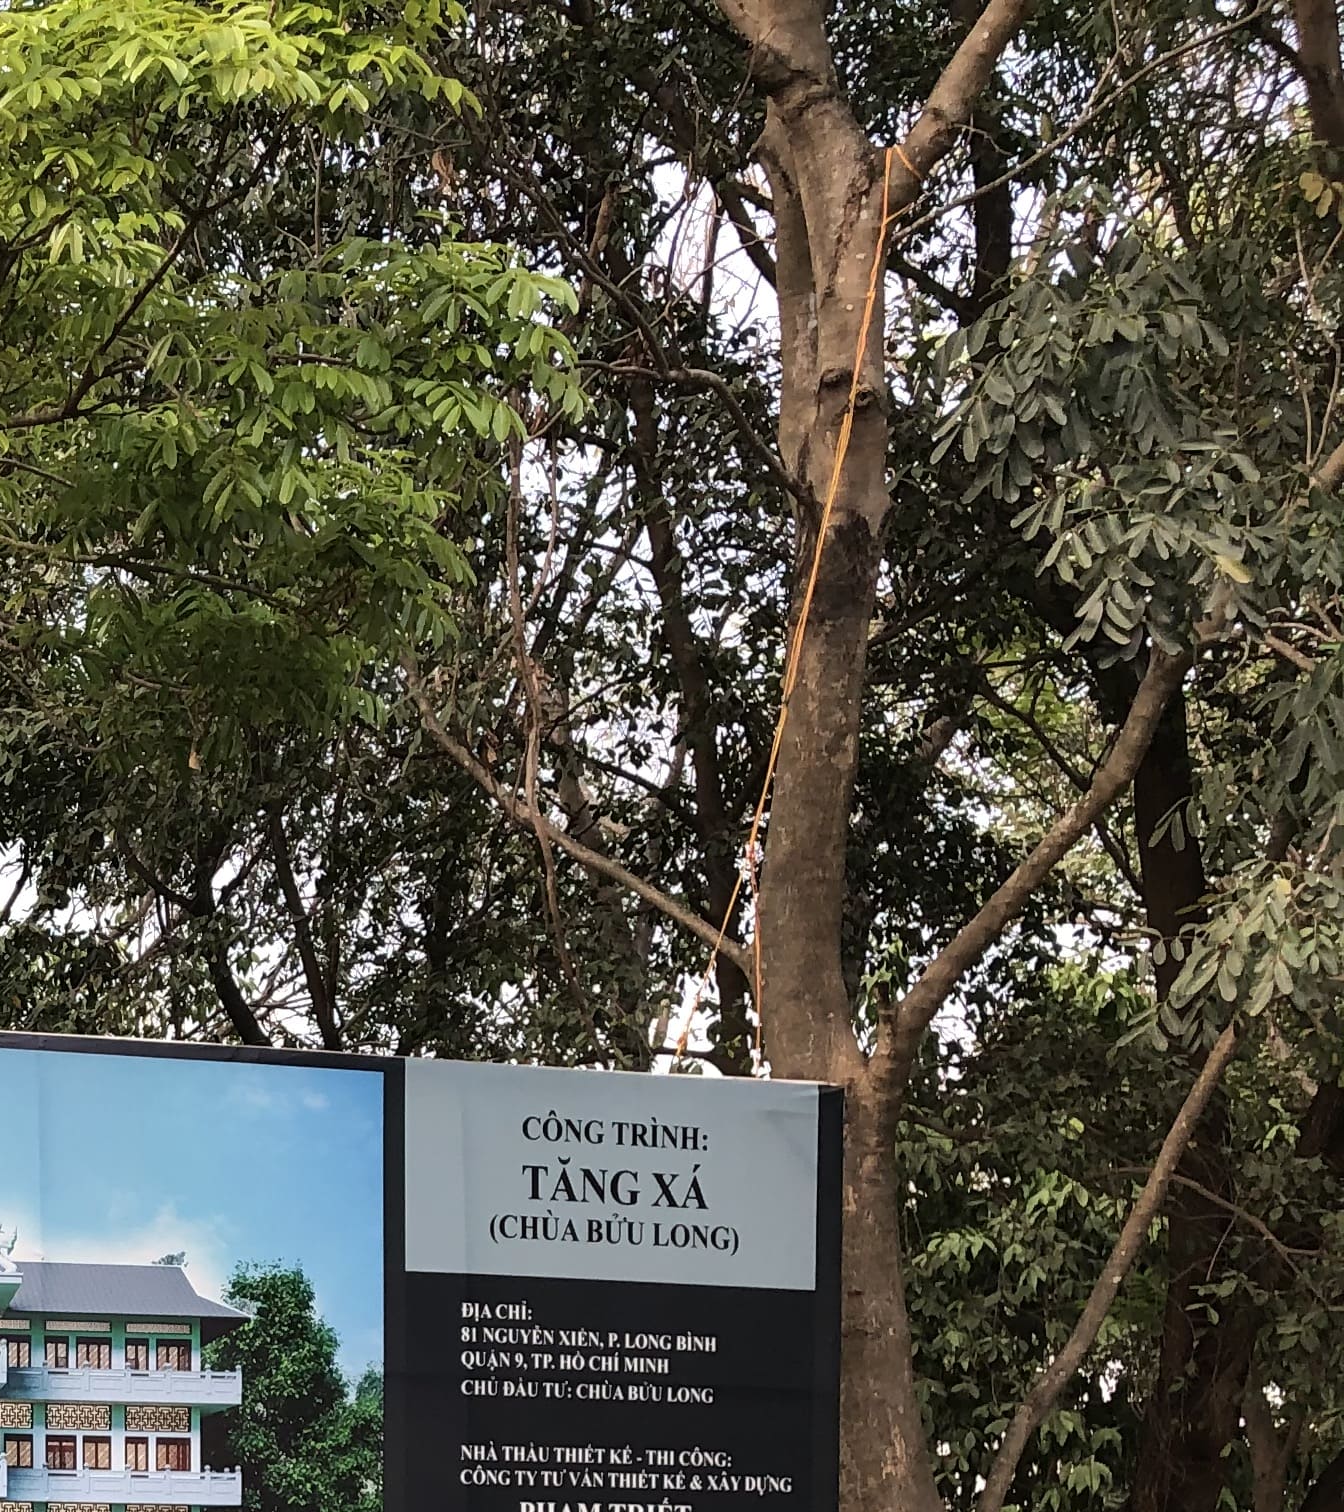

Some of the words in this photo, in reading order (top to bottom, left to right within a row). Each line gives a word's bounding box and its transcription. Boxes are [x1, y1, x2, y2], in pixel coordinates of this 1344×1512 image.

[522, 1110, 604, 1145] CÔNG
[612, 1117, 708, 1151] TRÌNH:
[522, 1156, 640, 1206] TĂNG
[652, 1164, 709, 1210] XÁ
[489, 1210, 580, 1243] (CHÙA
[587, 1213, 645, 1246] BỬU
[653, 1223, 739, 1256] LONG)
[461, 1302, 492, 1322] ĐỊA
[461, 1326, 477, 1342] 81
[608, 1332, 621, 1348] P.
[625, 1333, 672, 1350] LONG
[676, 1330, 717, 1352] BÌNH
[461, 1348, 511, 1371] QUẬN
[514, 1352, 528, 1371] 9,
[531, 1353, 556, 1370] TP.
[589, 1351, 619, 1372] CHÍ
[624, 1356, 669, 1374] MINH
[543, 1380, 572, 1399] TƯ:
[576, 1379, 624, 1401] CHÙA
[667, 1386, 714, 1404] LONG
[461, 1440, 498, 1461] NHÀ
[645, 1450, 675, 1466] THI
[678, 1446, 733, 1468] CÔNG:
[460, 1464, 511, 1486] CÔNG
[514, 1470, 538, 1487] TY
[541, 1468, 567, 1487] TƯ
[690, 1474, 703, 1490] &
[707, 1471, 742, 1491] XÂY
[744, 1474, 793, 1496] DỰNG
